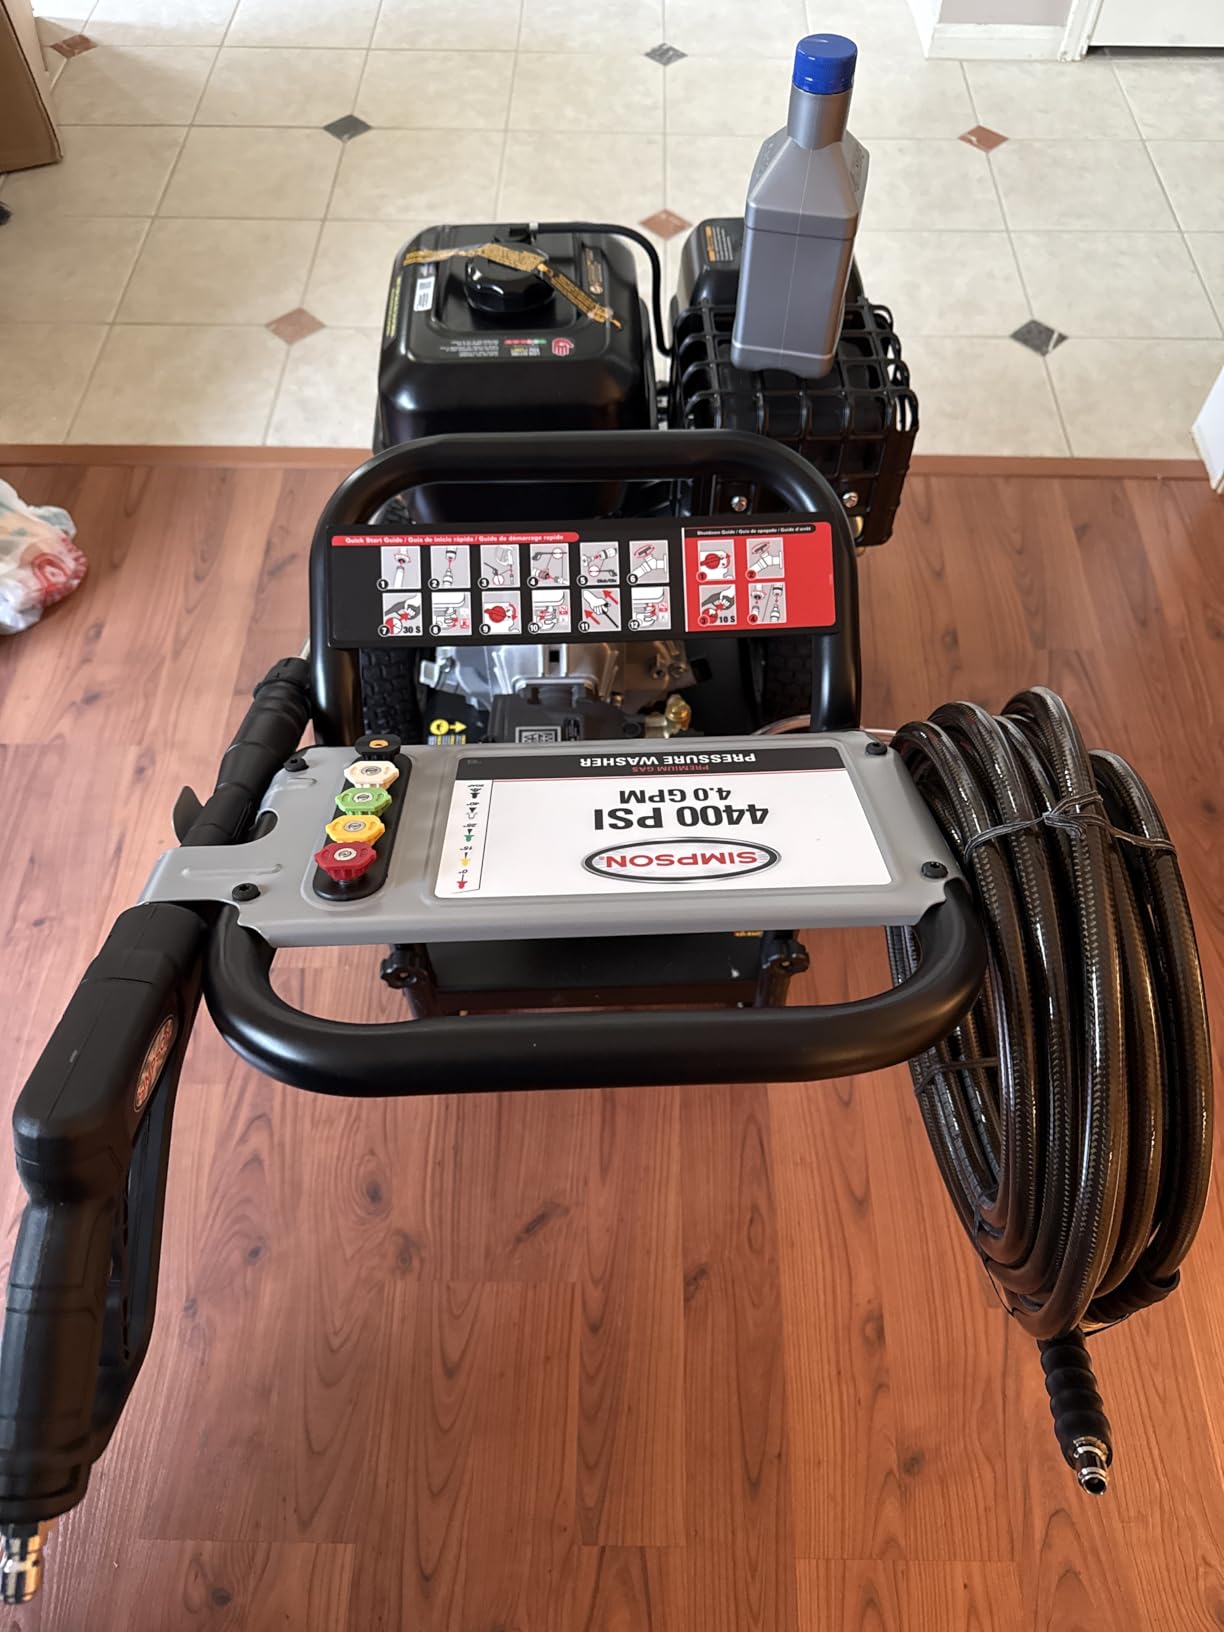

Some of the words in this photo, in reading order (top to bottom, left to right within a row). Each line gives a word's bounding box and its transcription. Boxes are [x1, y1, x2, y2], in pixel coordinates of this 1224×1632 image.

[479, 535, 497, 543] Guide
[730, 615, 735, 623] S
[529, 624, 538, 632] 10
[581, 623, 588, 631] 11
[630, 621, 639, 629] 12
[403, 626, 414, 634] 30
[579, 755, 659, 767] WASHER
[663, 753, 756, 765] PRESSURE
[632, 765, 655, 773] GAS
[657, 764, 710, 772] PREMIUM
[619, 789, 686, 804] GPM
[694, 787, 732, 802] 4.0
[594, 807, 664, 830] PSI
[676, 804, 769, 827] 4400
[605, 851, 758, 868] SIMPSON
